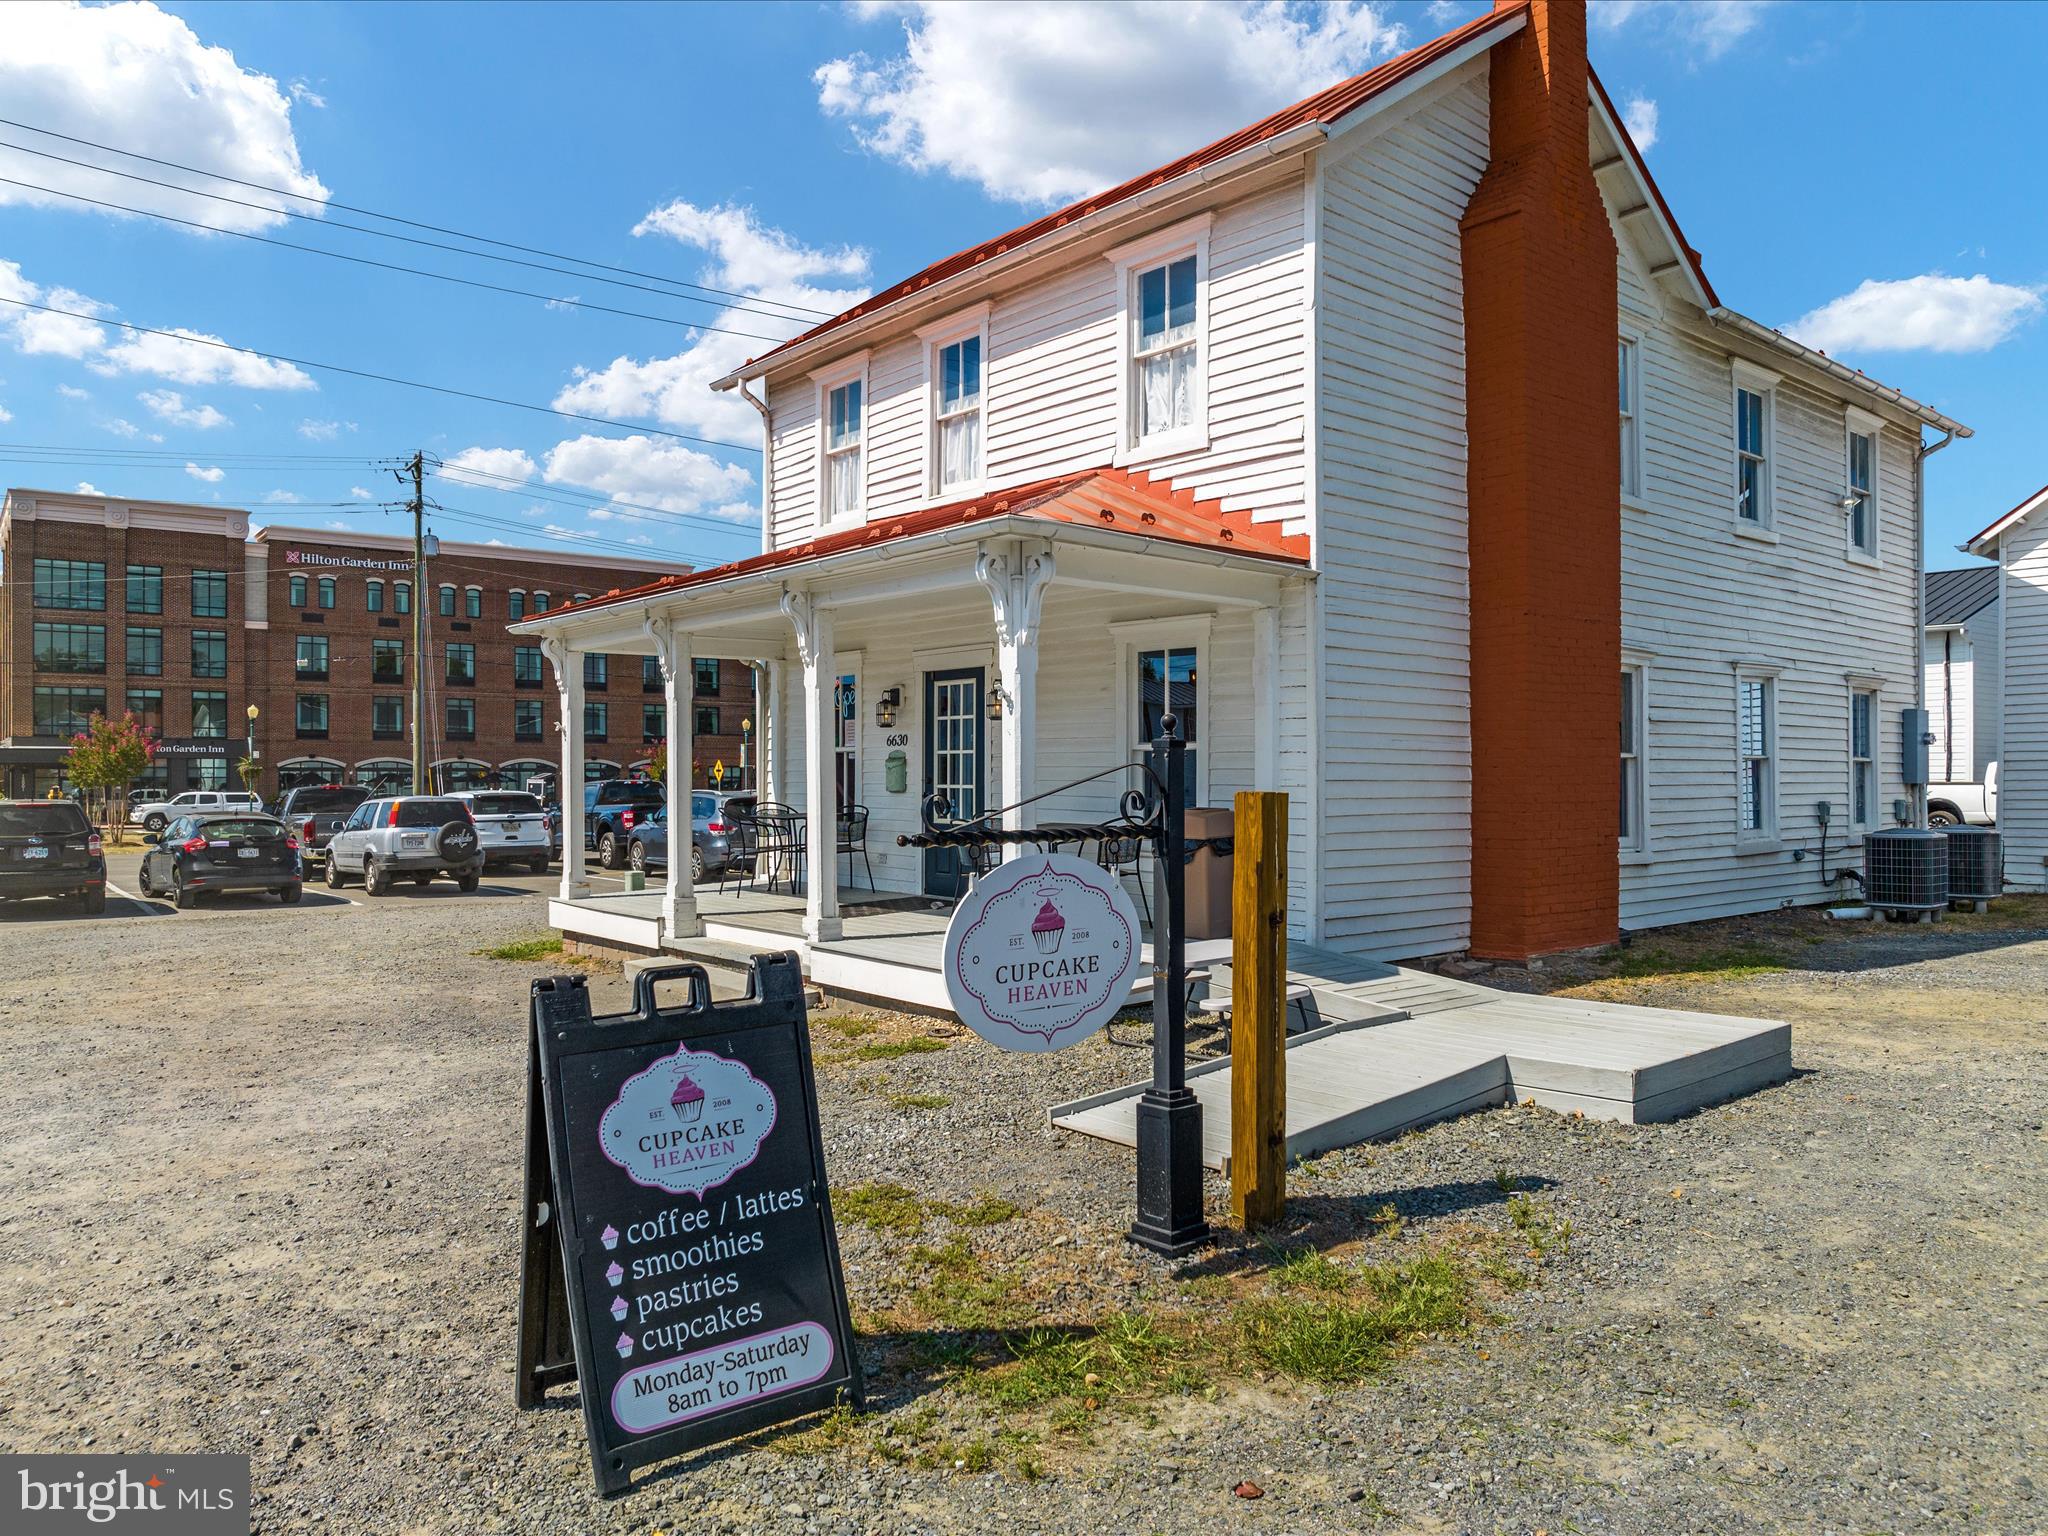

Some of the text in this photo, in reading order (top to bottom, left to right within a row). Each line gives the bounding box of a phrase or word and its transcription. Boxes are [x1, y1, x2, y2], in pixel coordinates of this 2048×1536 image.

[301, 553, 409, 571] Hilton Garden Inn
[173, 744, 207, 753] Garden
[208, 745, 225, 753] Inn
[886, 734, 909, 747] 6630
[1009, 931, 1090, 947] EST. 2008
[995, 955, 1100, 985] CUPCAKE
[1008, 978, 1088, 1005] HEAVEN
[712, 1098, 732, 1108] 2008
[638, 1119, 745, 1153] CUPCAKE
[653, 1140, 736, 1169] HEAVEN
[627, 1208, 711, 1244] coffee
[735, 1188, 804, 1220] lattes
[632, 1232, 764, 1280] smoothies
[635, 1272, 740, 1324] pastries
[641, 1302, 764, 1351] cupcakes
[632, 1333, 811, 1398] Monday-Saturday
[668, 1365, 788, 1413] 8am to 7pm
